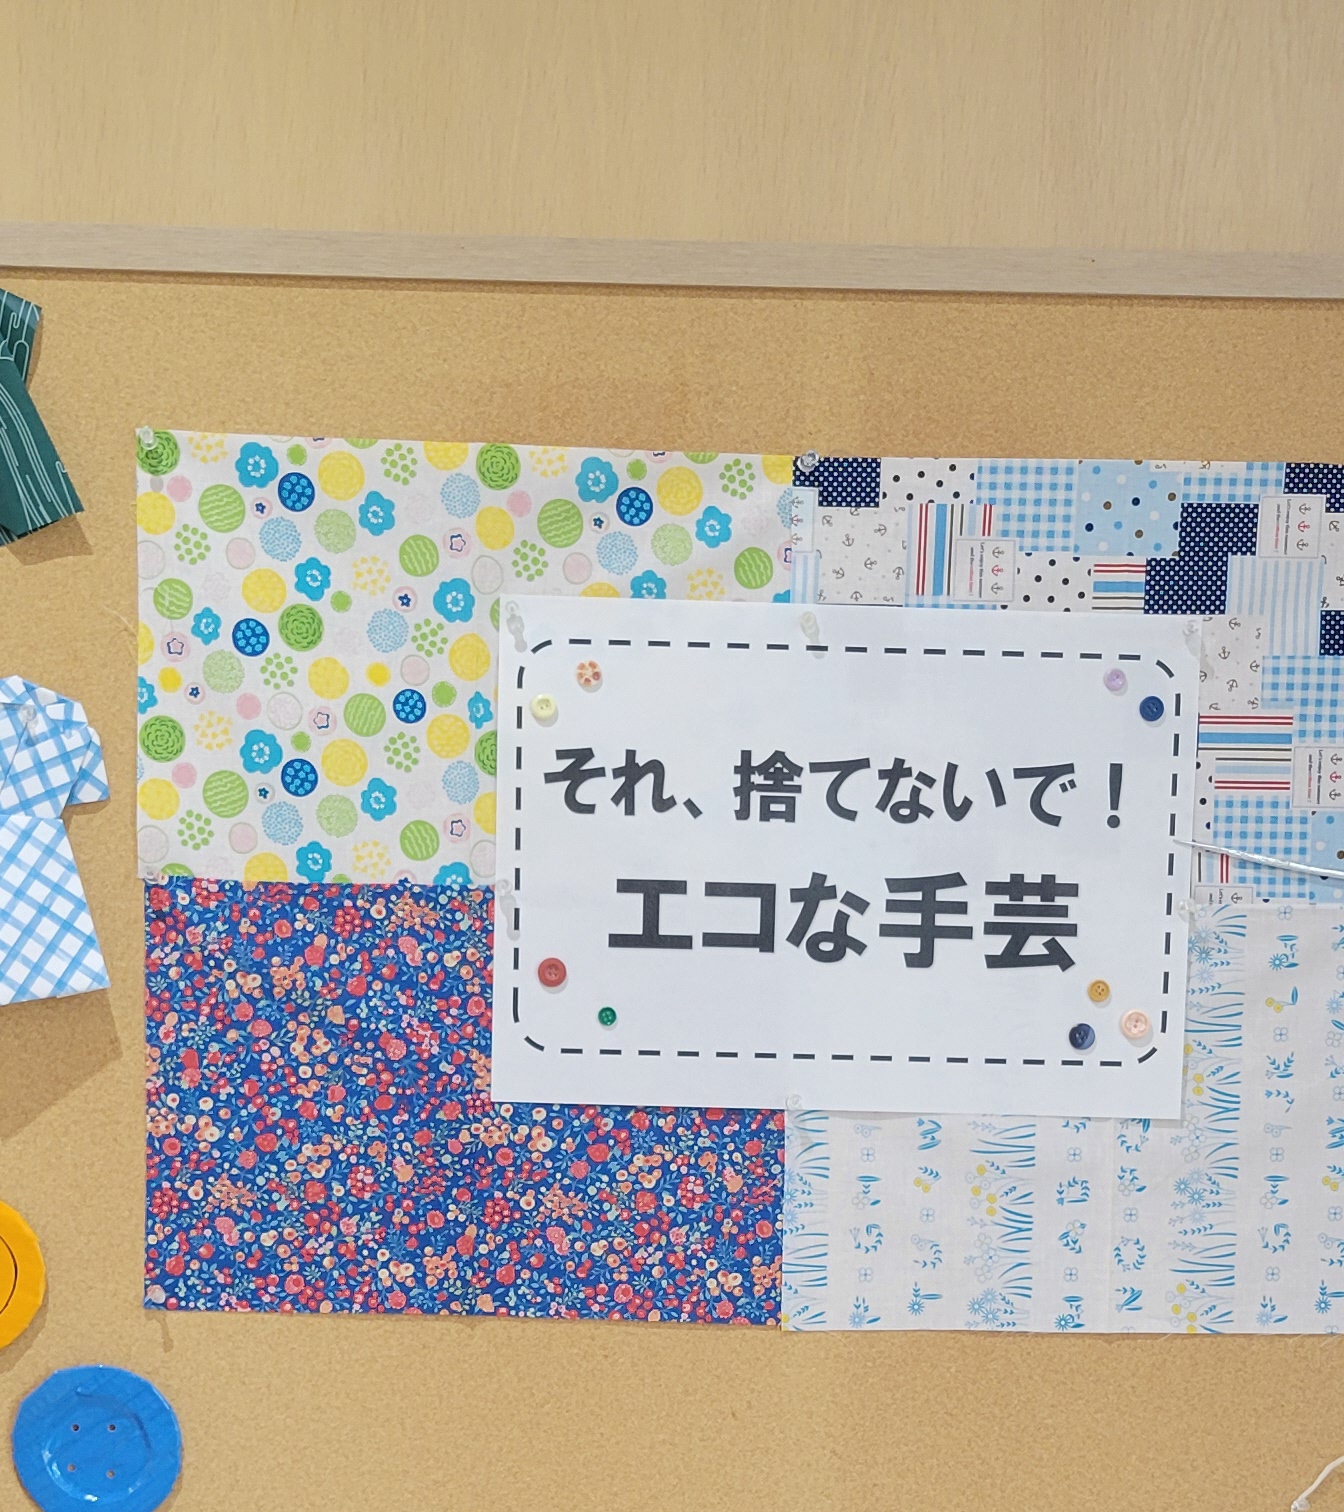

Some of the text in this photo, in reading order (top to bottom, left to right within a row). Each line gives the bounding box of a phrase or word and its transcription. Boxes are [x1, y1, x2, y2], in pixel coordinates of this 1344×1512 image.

[543, 747, 1124, 829] それ、捨てないで！
[608, 871, 1080, 973] エコな手芸
